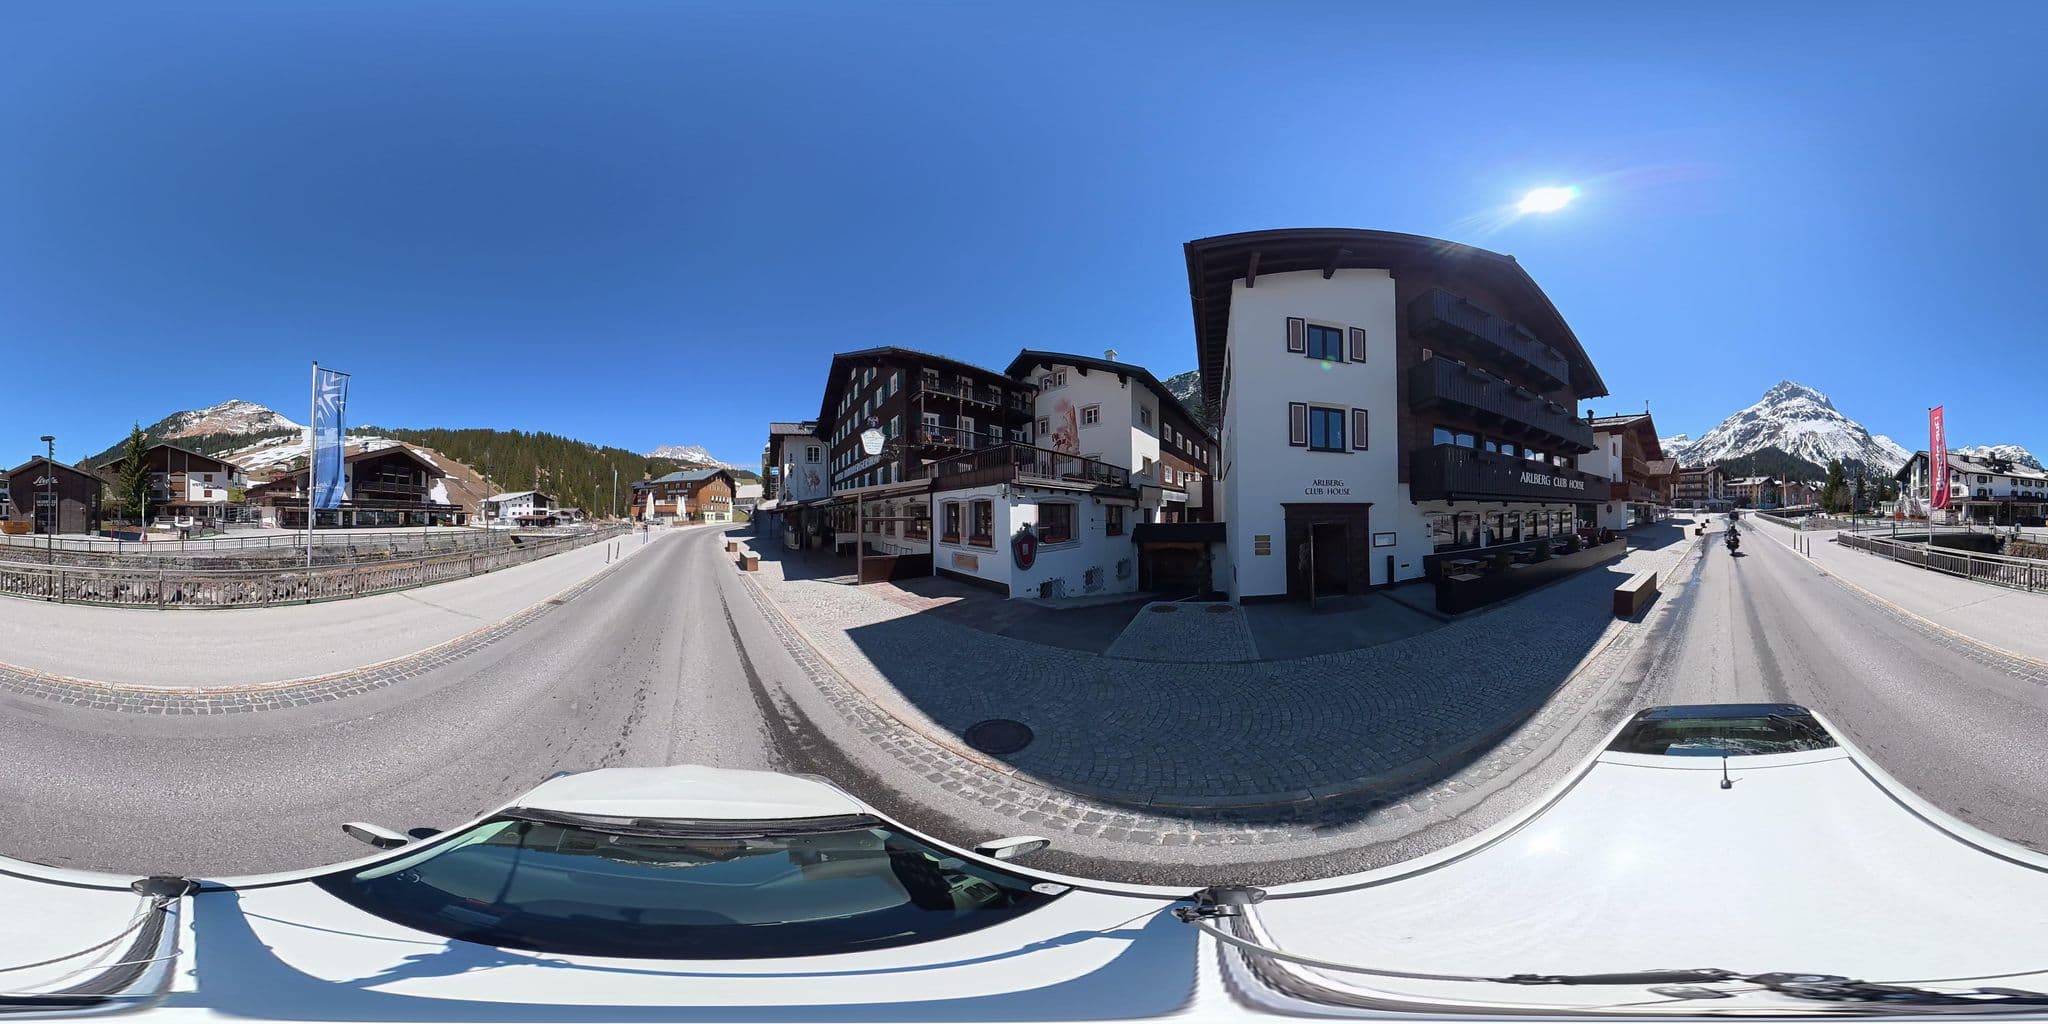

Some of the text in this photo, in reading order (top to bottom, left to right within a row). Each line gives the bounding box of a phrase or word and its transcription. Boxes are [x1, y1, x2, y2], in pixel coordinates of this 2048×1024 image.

[1312, 479, 1344, 487] ARLBERG
[1520, 472, 1584, 490] ARLBERG CLUB HOUSE
[1305, 487, 1351, 495] CLUB HOUSE
